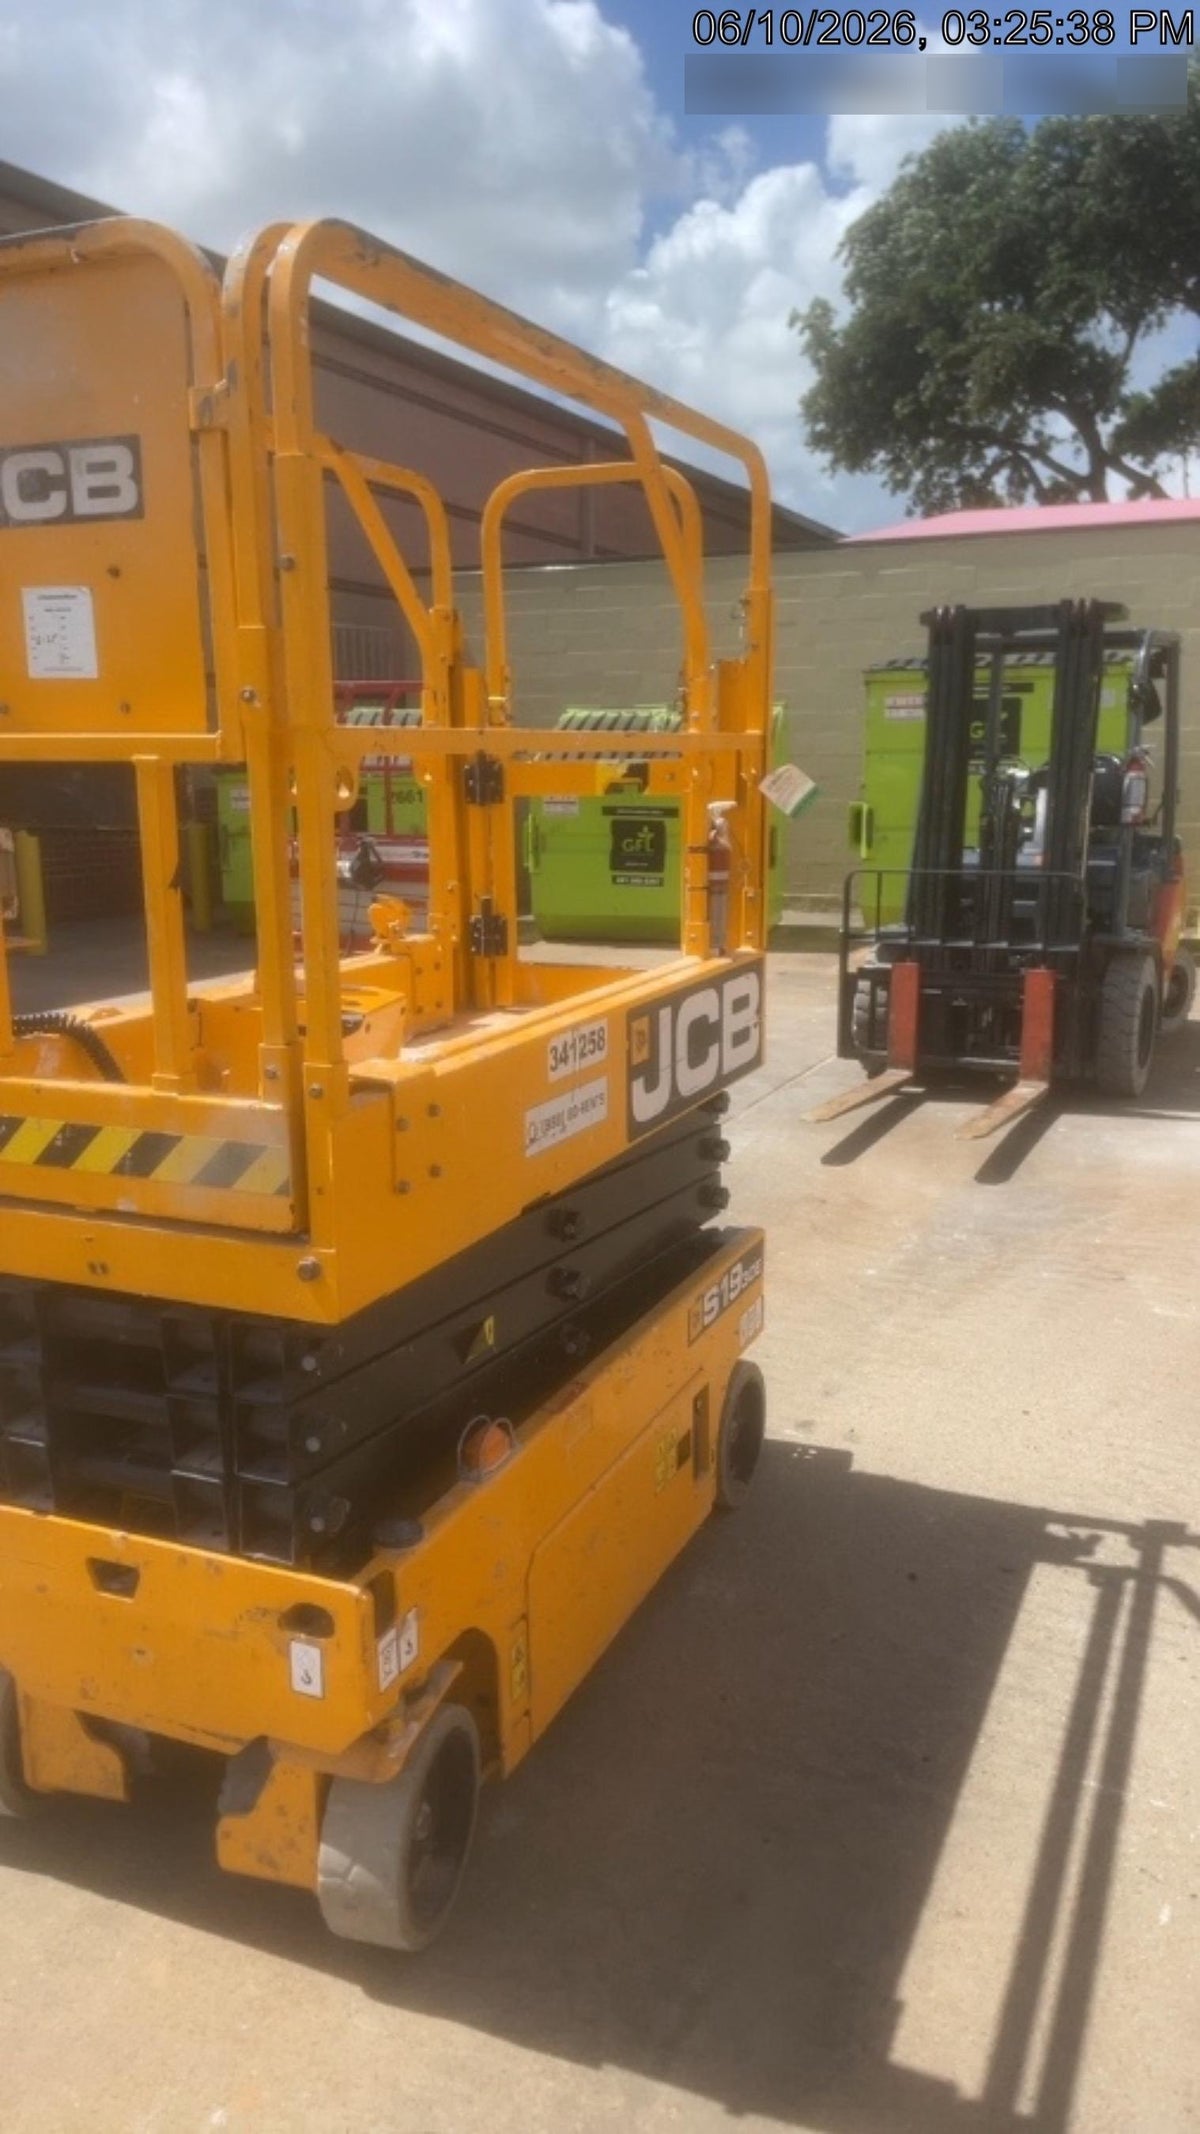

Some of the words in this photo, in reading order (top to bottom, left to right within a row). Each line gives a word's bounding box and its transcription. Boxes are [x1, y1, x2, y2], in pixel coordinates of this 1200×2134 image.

[0, 444, 139, 520] CB
[549, 1025, 606, 1073] 341258
[631, 971, 761, 1122] JCB
